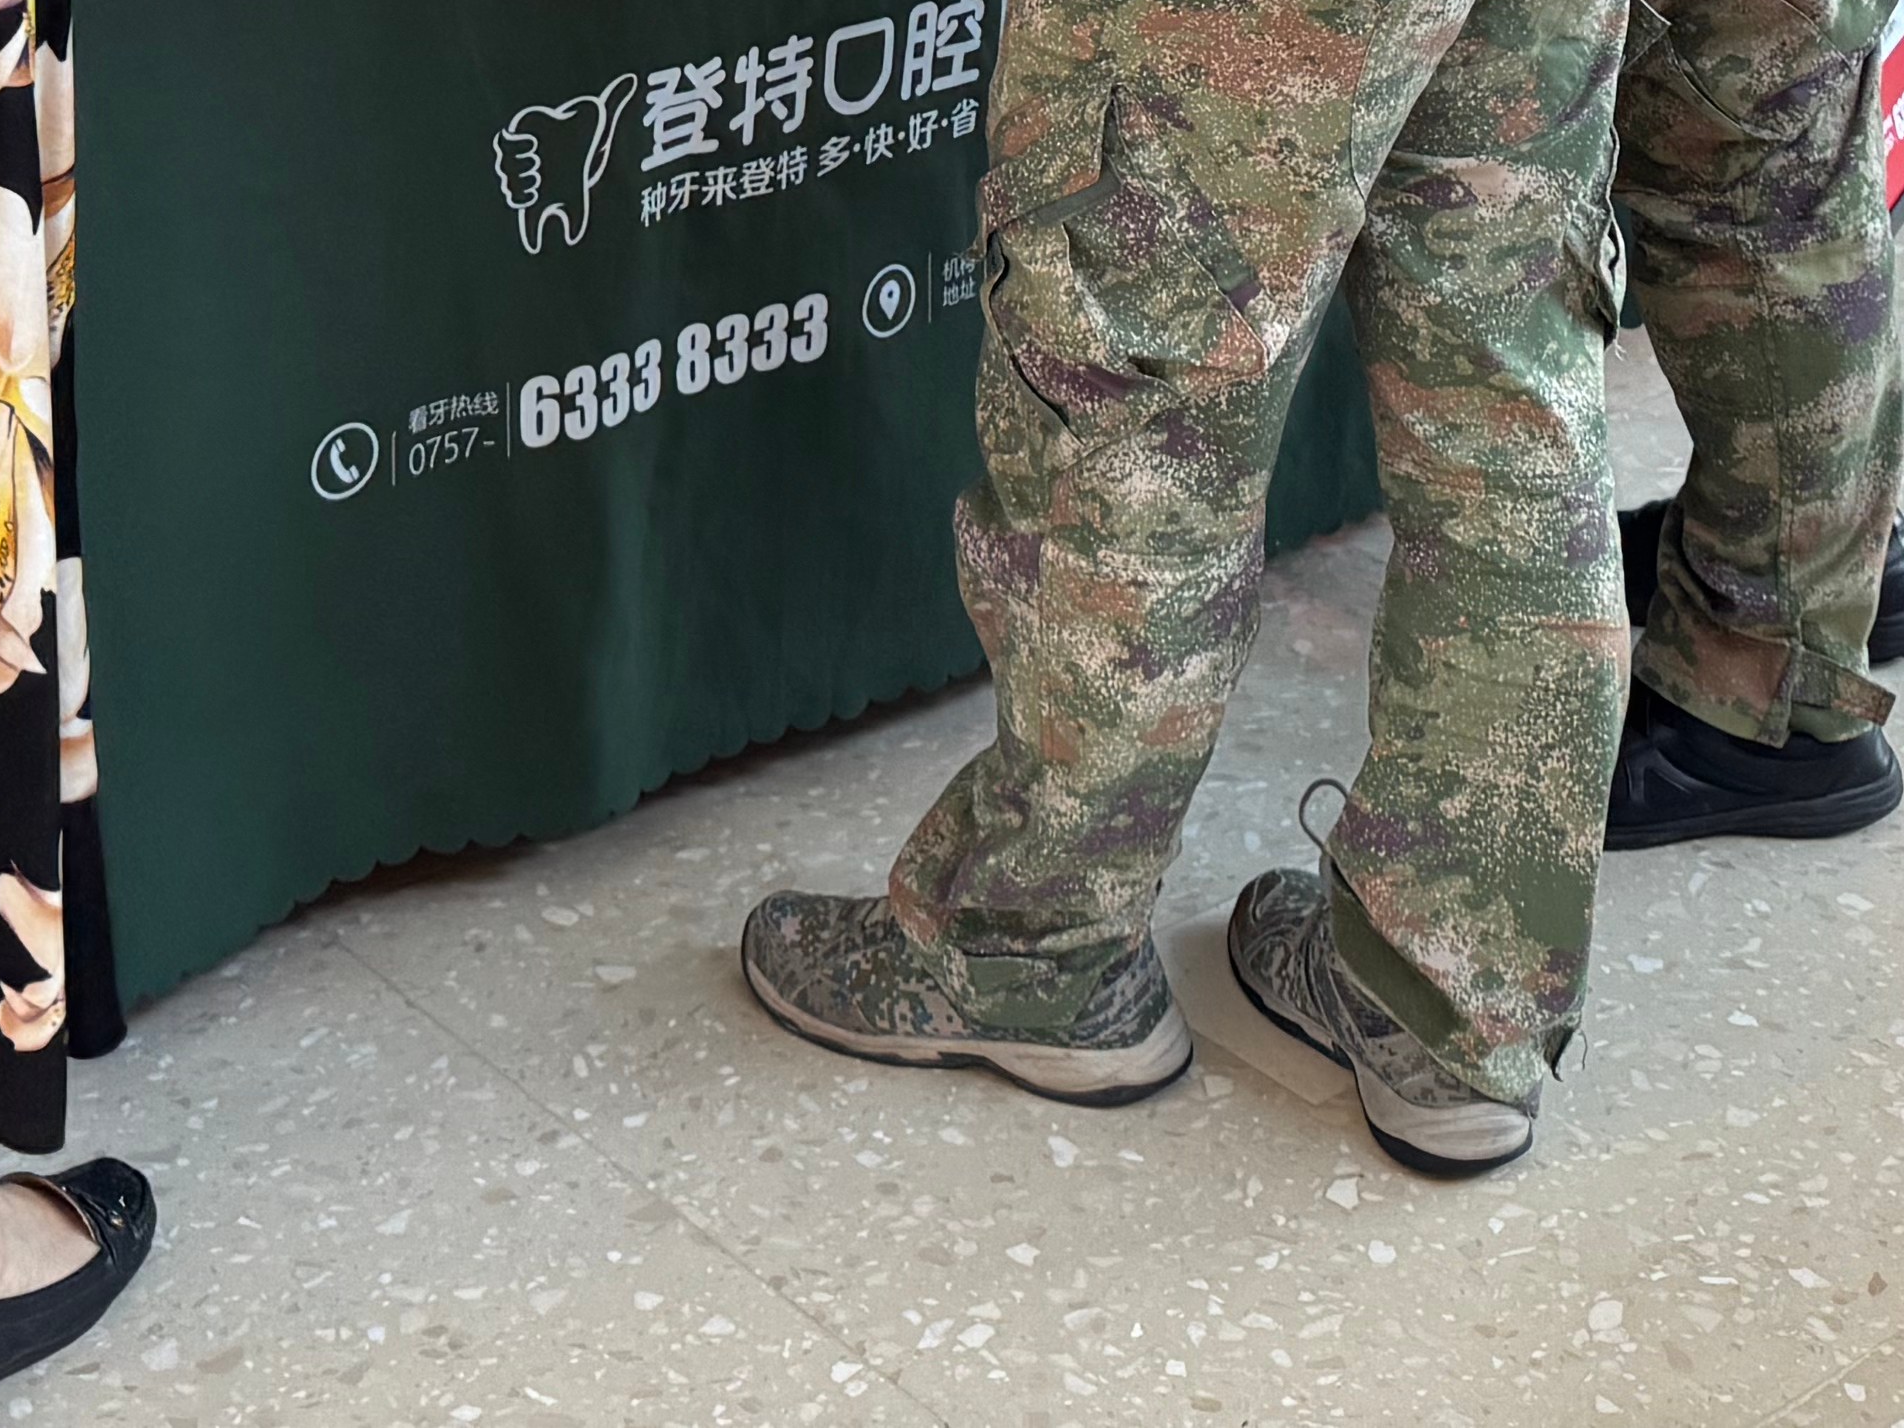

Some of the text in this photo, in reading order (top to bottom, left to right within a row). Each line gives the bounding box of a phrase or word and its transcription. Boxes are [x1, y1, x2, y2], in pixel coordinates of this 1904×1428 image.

[641, 144, 808, 228] 种牙来登特
[943, 275, 976, 307] 地址
[408, 292, 829, 476] 0757- 6333 8333
